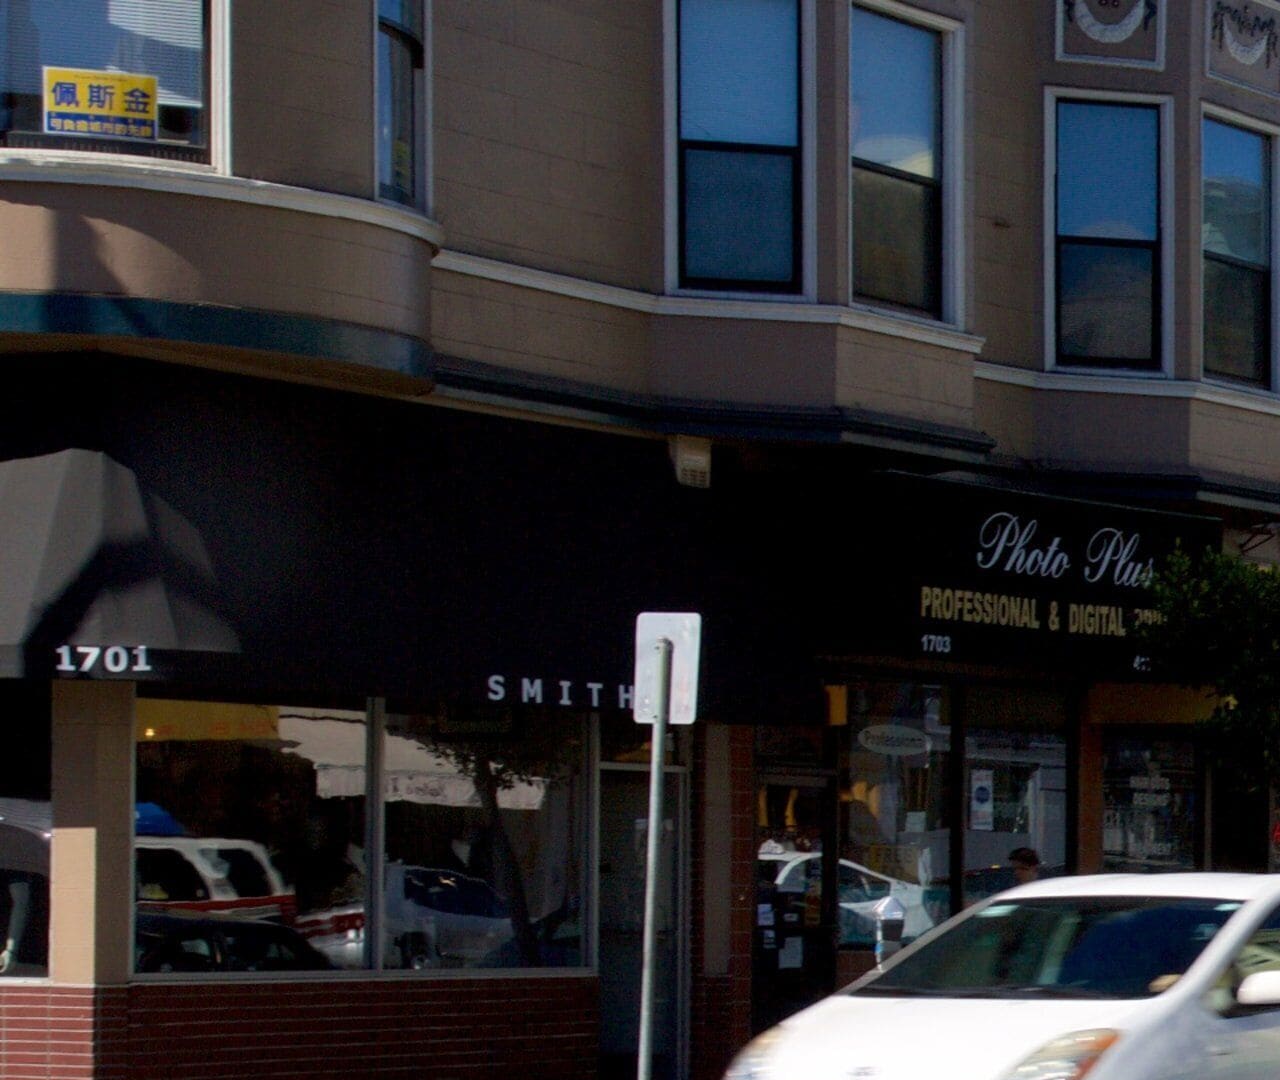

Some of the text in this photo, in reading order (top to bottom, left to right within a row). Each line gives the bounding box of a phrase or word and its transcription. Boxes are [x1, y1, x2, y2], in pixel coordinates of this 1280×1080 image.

[53, 81, 150, 113] 佩斯金
[976, 511, 1154, 589] Photo Plus
[920, 586, 1040, 630] PROFESSIONAL
[1048, 600, 1061, 632] &
[1068, 603, 1127, 637] DIGITAL
[56, 646, 152, 673] 1701
[920, 634, 952, 653] 1703
[487, 674, 634, 708] SMITH
